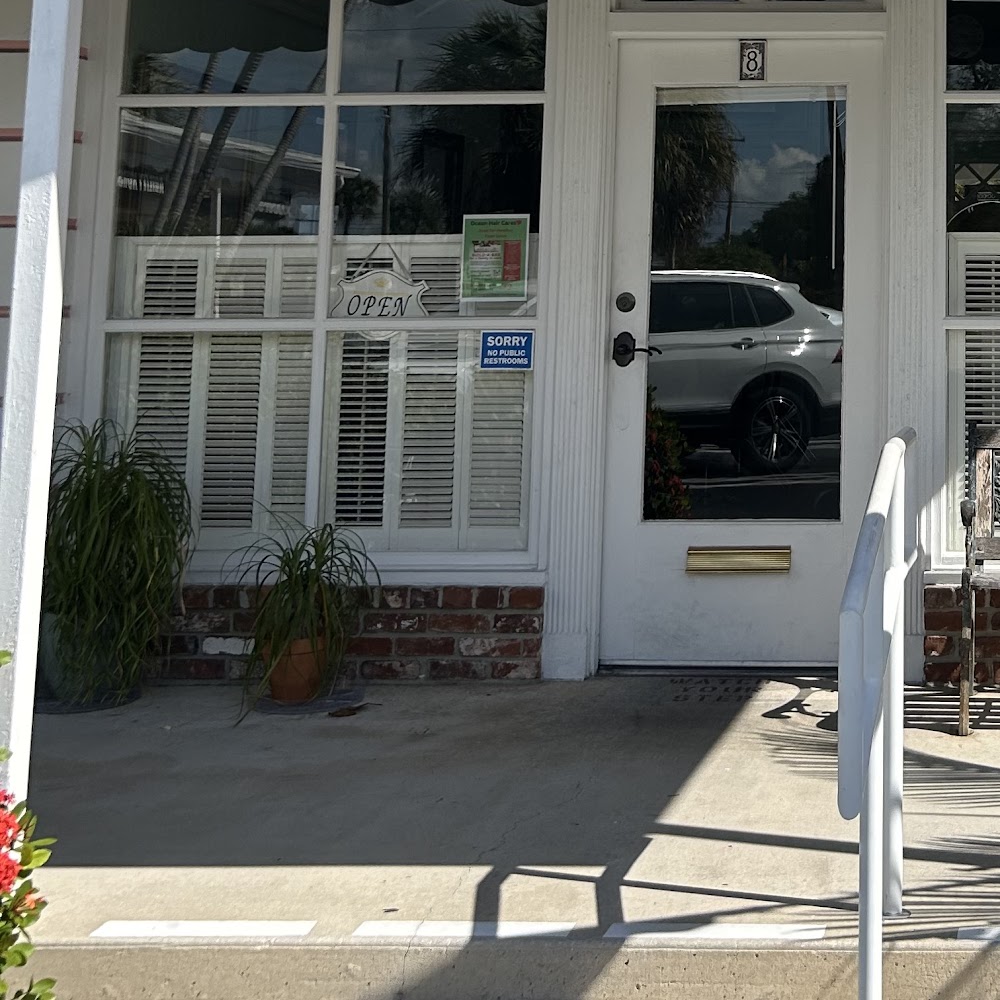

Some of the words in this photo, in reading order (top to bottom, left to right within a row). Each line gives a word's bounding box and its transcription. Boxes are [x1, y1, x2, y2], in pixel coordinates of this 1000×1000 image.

[746, 50, 758, 72] 8
[347, 294, 413, 317] OPEN
[486, 335, 528, 347] SORRY
[487, 349, 499, 357] NO
[499, 349, 526, 357] PUBLIC
[483, 357, 529, 365] RESTROOMS
